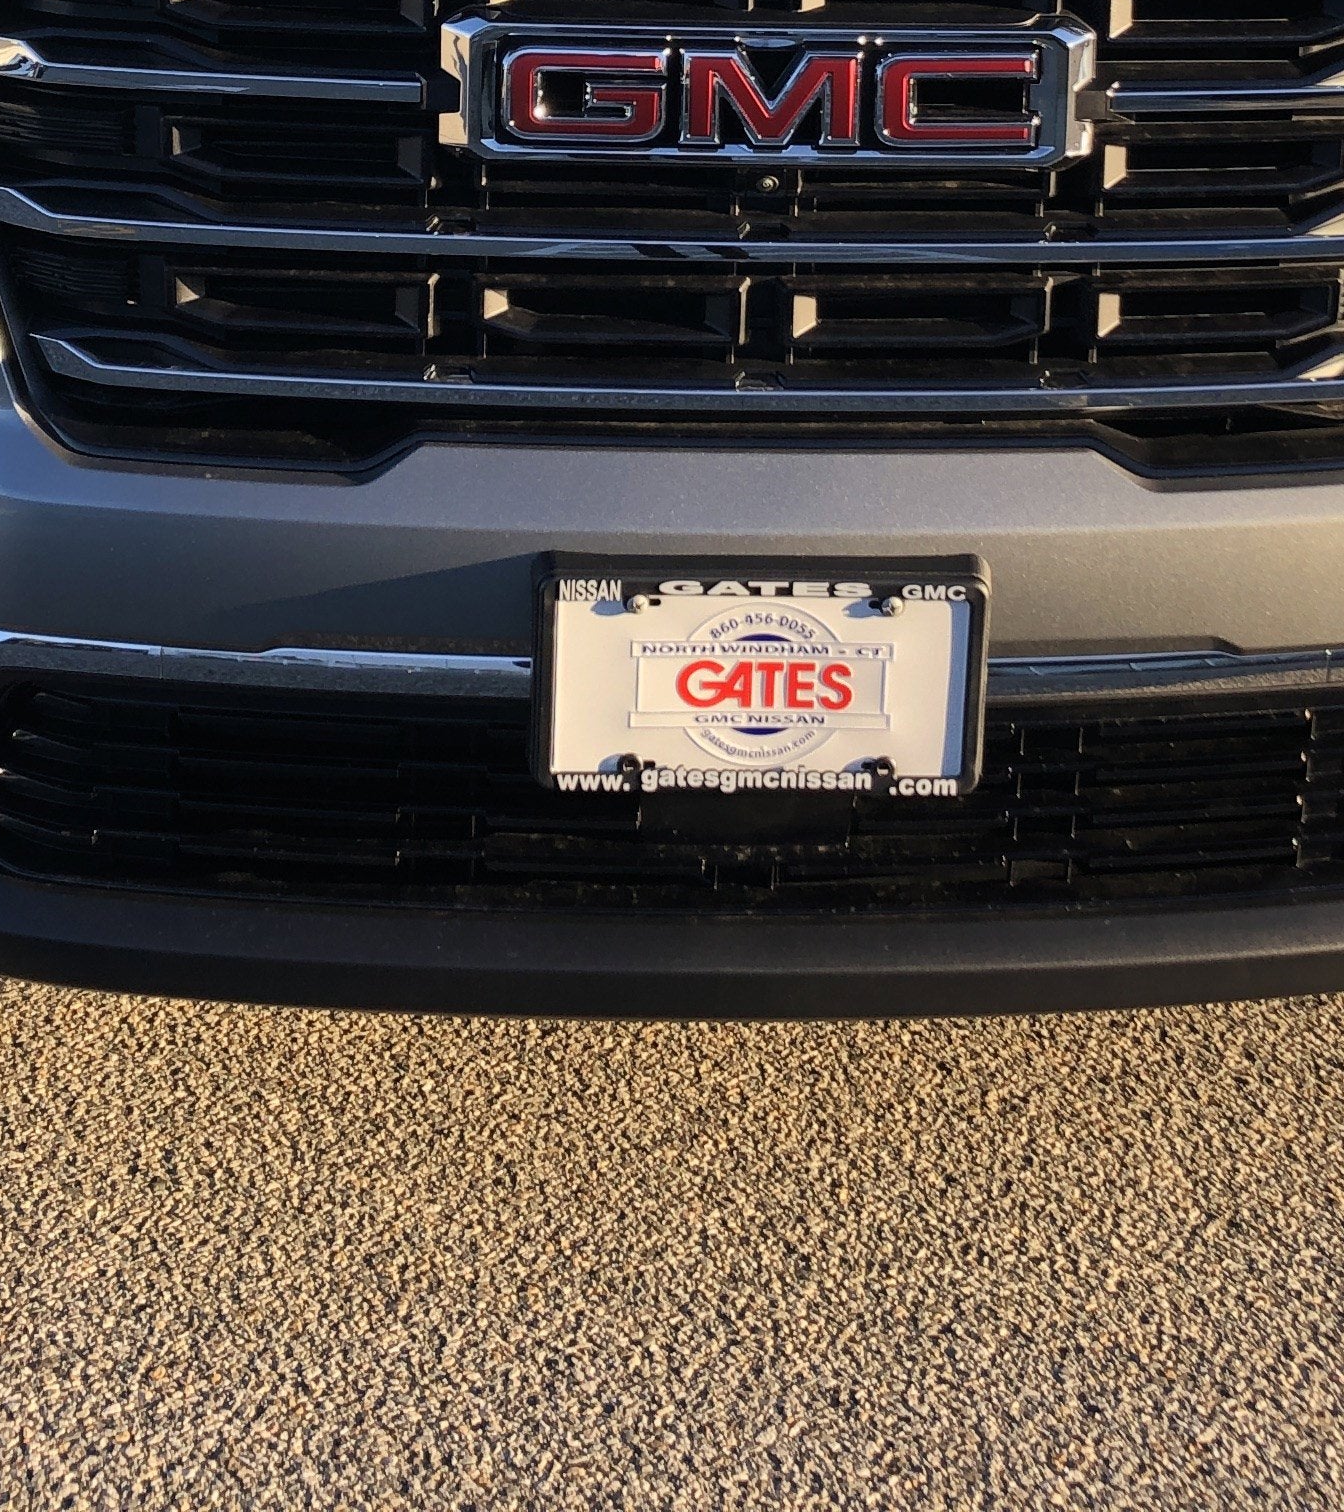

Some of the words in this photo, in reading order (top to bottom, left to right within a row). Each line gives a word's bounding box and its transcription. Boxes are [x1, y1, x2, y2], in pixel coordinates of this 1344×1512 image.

[501, 44, 1039, 148] GMC
[559, 579, 622, 602] NISSAN
[659, 580, 873, 598] GATES
[902, 584, 967, 602] GMC
[709, 612, 816, 640] 860-456-0055
[641, 644, 715, 654] NORTH
[721, 644, 829, 655] WINDHAM
[857, 646, 882, 656] CT
[676, 660, 853, 711] GATES
[694, 713, 742, 724] GMC
[748, 714, 825, 725] NISSAN
[700, 728, 816, 758] gatesgmcnissan.com
[556, 773, 631, 792] www.
[640, 765, 872, 794] gatesgmcnissan
[888, 777, 957, 797] .com
